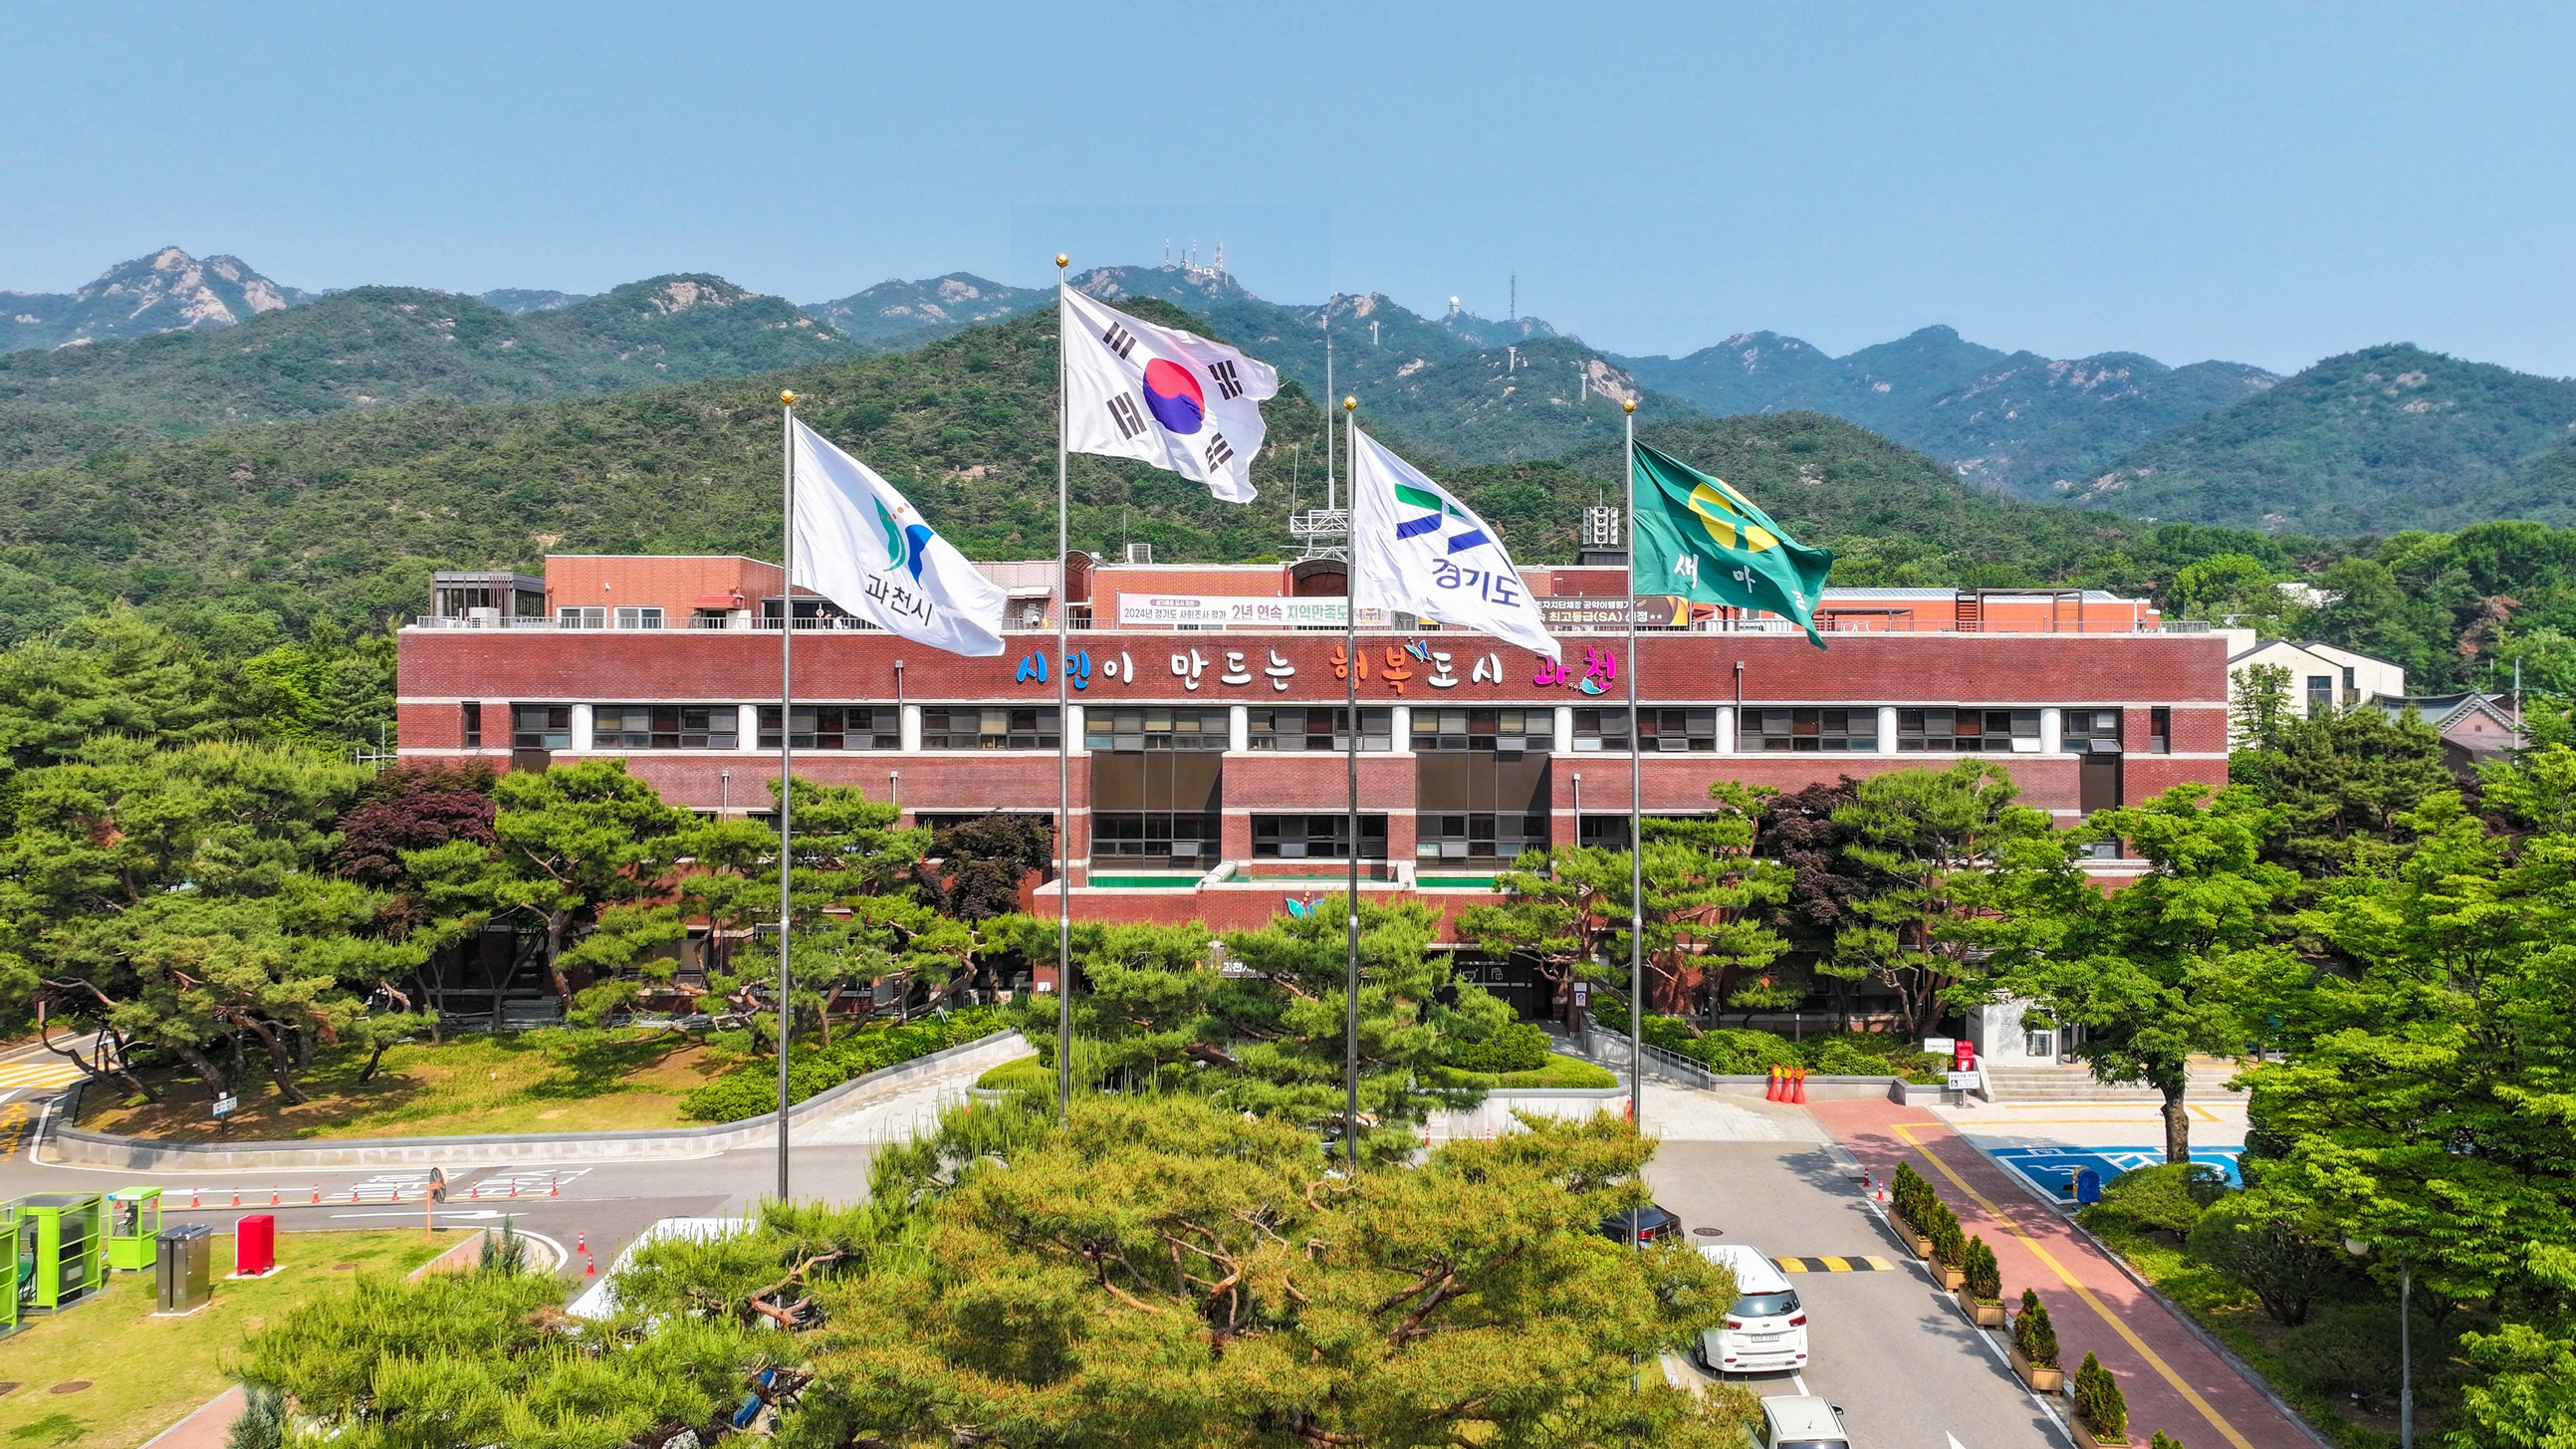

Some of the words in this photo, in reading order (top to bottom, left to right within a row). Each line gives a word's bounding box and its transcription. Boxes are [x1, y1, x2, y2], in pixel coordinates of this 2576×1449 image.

[865, 574, 933, 626] 과천시
[1432, 558, 1521, 608] 경기도
[1124, 607, 1153, 618] 2024년
[1155, 608, 1177, 619] 경기도
[1179, 609, 1209, 619] 사회조사
[1211, 609, 1227, 619] 결과
[1232, 604, 1253, 620] 2년
[1258, 604, 1283, 620] 연속
[1287, 604, 1348, 620] 지역만족도
[1549, 610, 1623, 622] 최고등급(SA)
[1016, 650, 1134, 689] 시민이
[1171, 648, 1296, 690] 만드는
[1533, 645, 1617, 690] 과천
